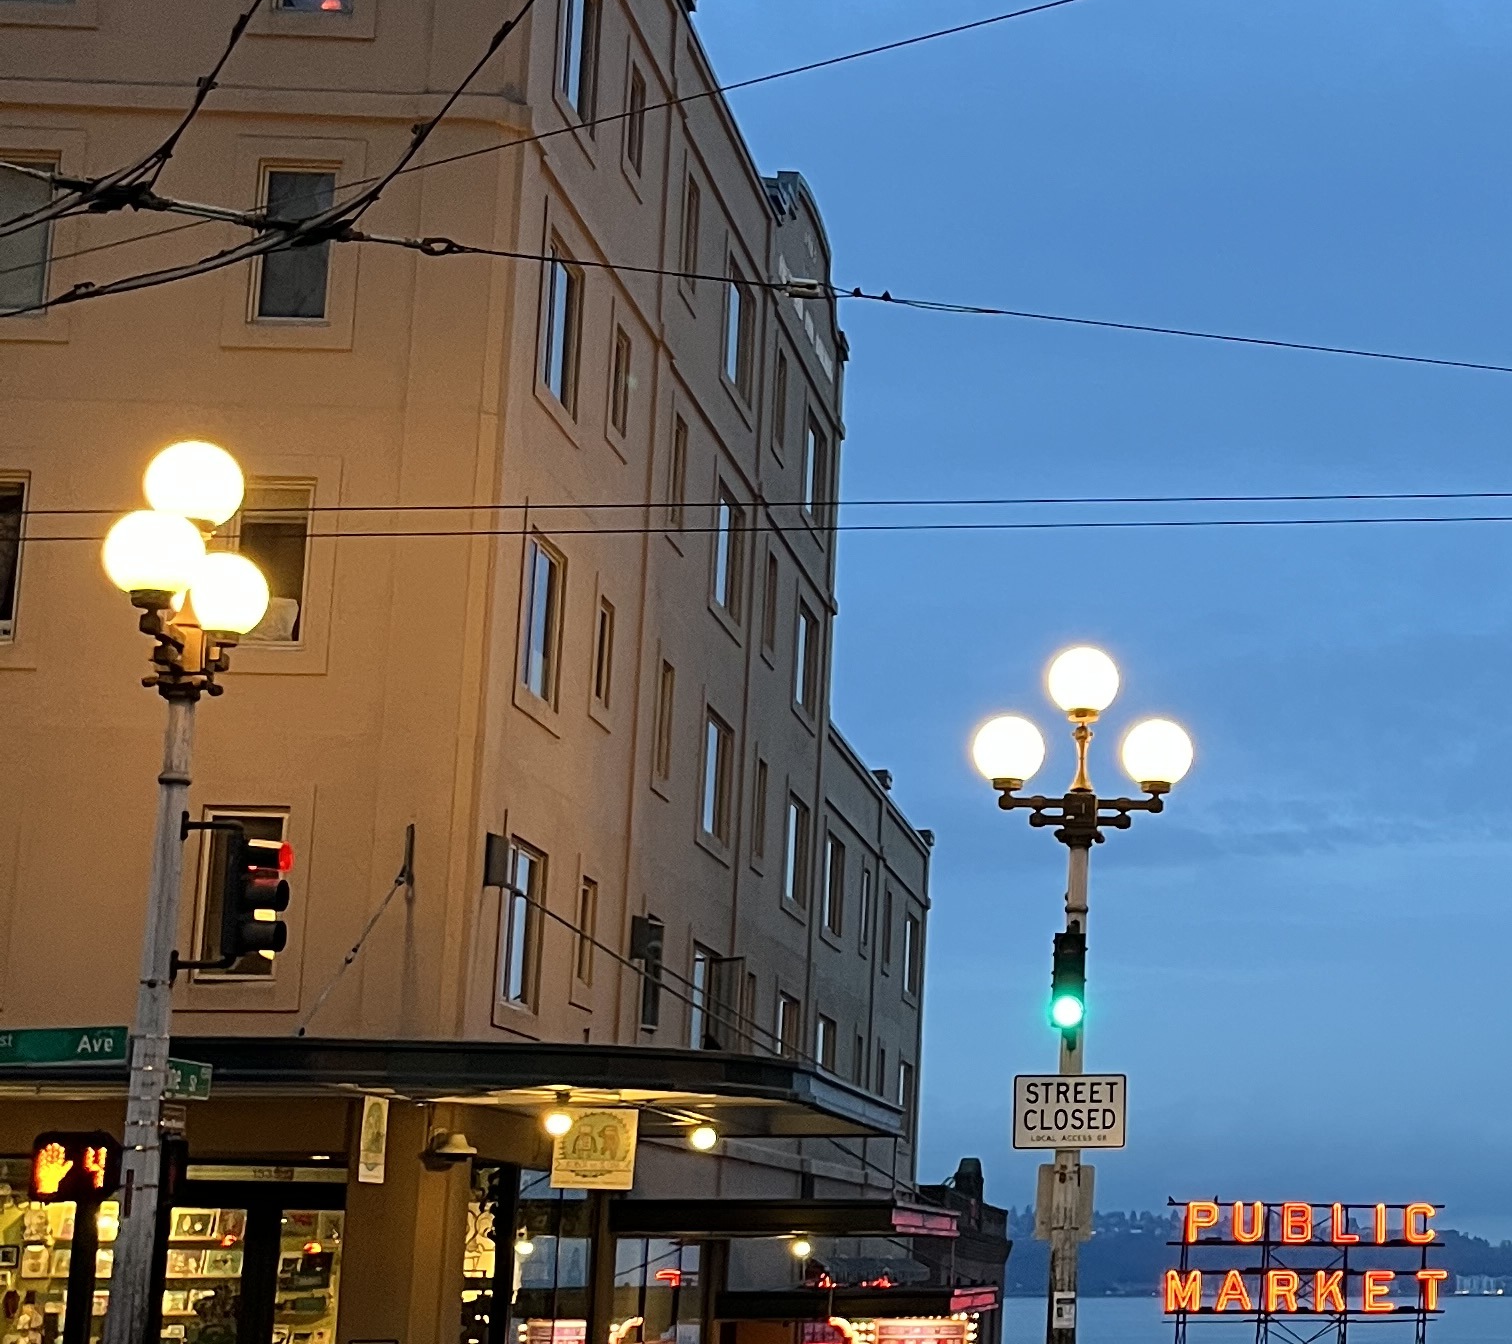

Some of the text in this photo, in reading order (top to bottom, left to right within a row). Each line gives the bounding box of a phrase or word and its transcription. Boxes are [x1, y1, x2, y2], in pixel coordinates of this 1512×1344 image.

[77, 1035, 114, 1053] Ave
[1026, 1082, 1118, 1104] STREET
[1023, 1108, 1116, 1131] CLOSED
[84, 1146, 108, 1188] 4
[1186, 1201, 1437, 1244] PUBLIC
[1165, 1269, 1448, 1313] MARKET
